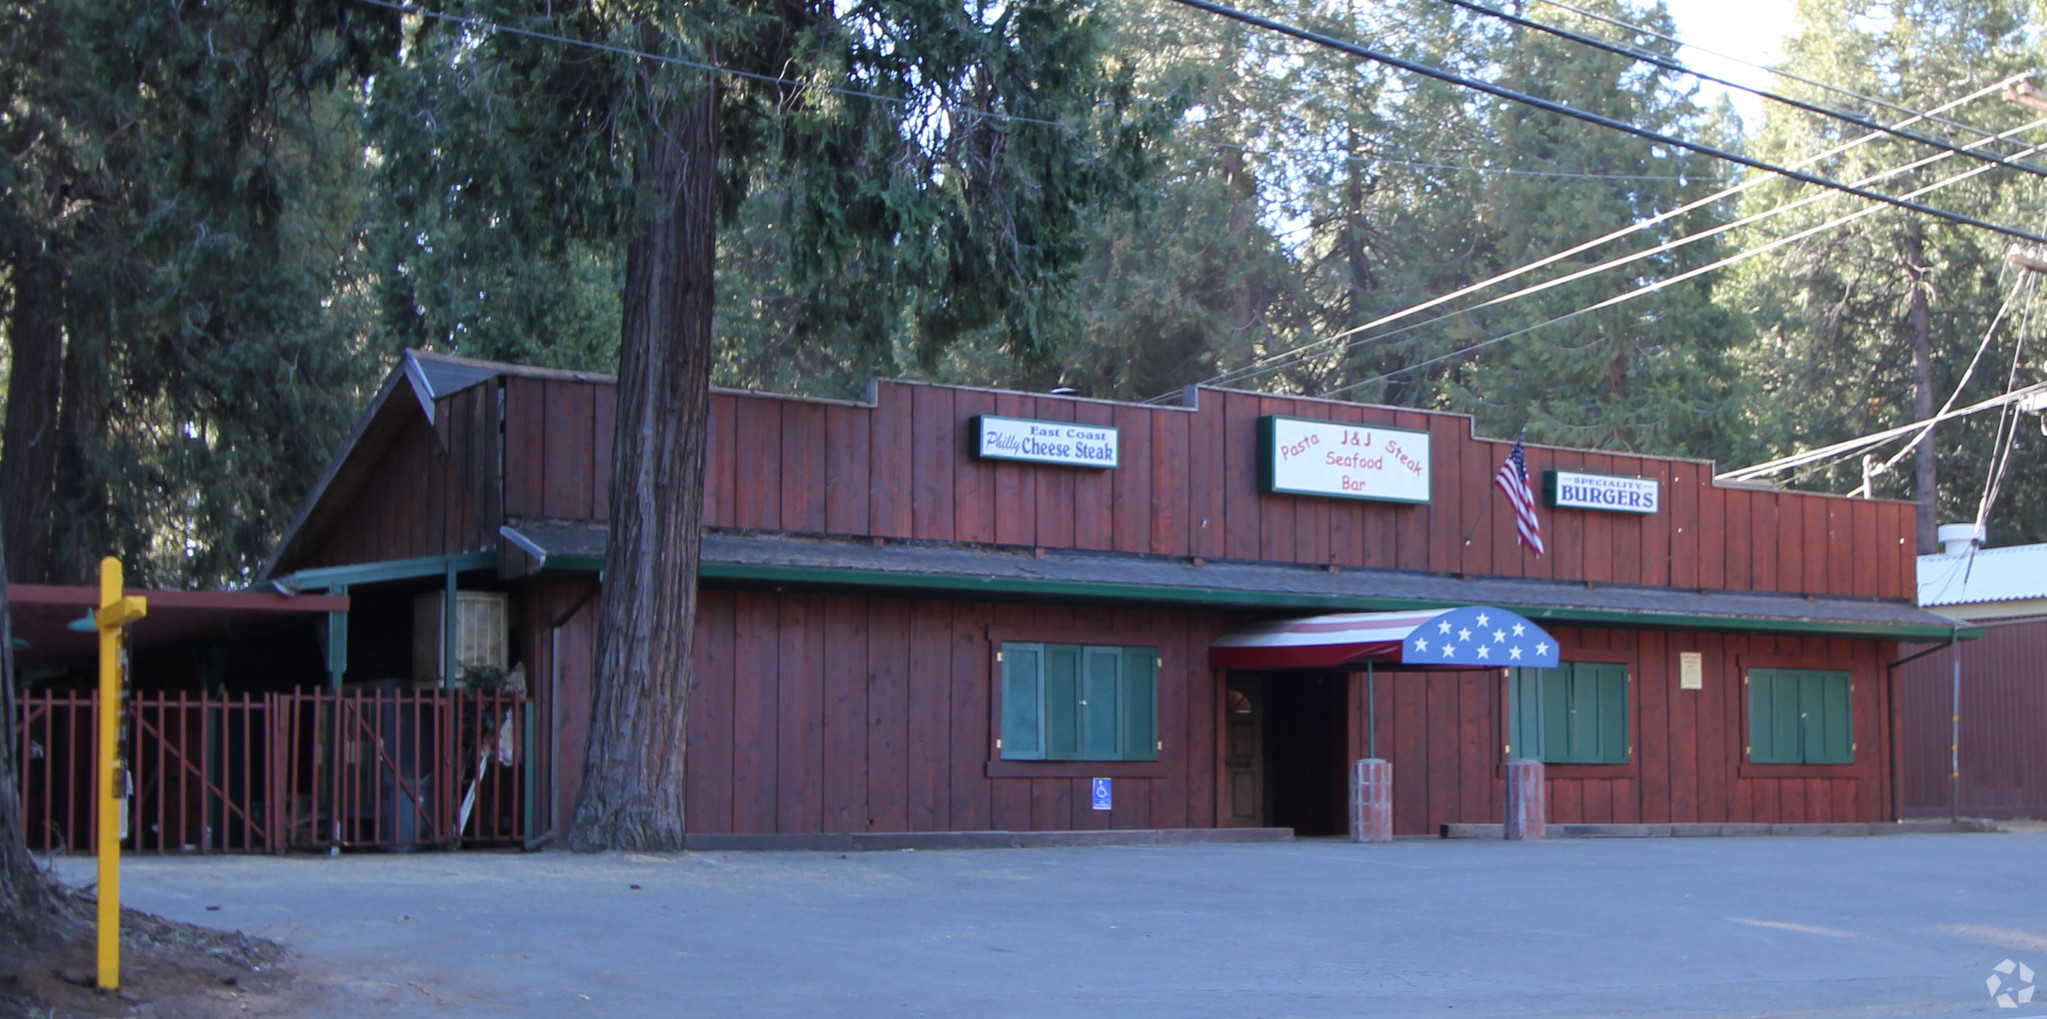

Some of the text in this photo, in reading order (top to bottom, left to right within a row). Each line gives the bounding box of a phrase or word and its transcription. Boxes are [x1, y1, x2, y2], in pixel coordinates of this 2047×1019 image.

[1030, 426, 1107, 441] East Coast
[986, 431, 1113, 461] Philly Cheese Steak
[1281, 433, 1320, 461] Pasta
[1325, 451, 1383, 470] Seafood
[1385, 440, 1423, 477] Steak
[1341, 475, 1366, 491] Bar
[1574, 477, 1643, 490] SPECIALITY
[1561, 485, 1654, 509] BURGERS
